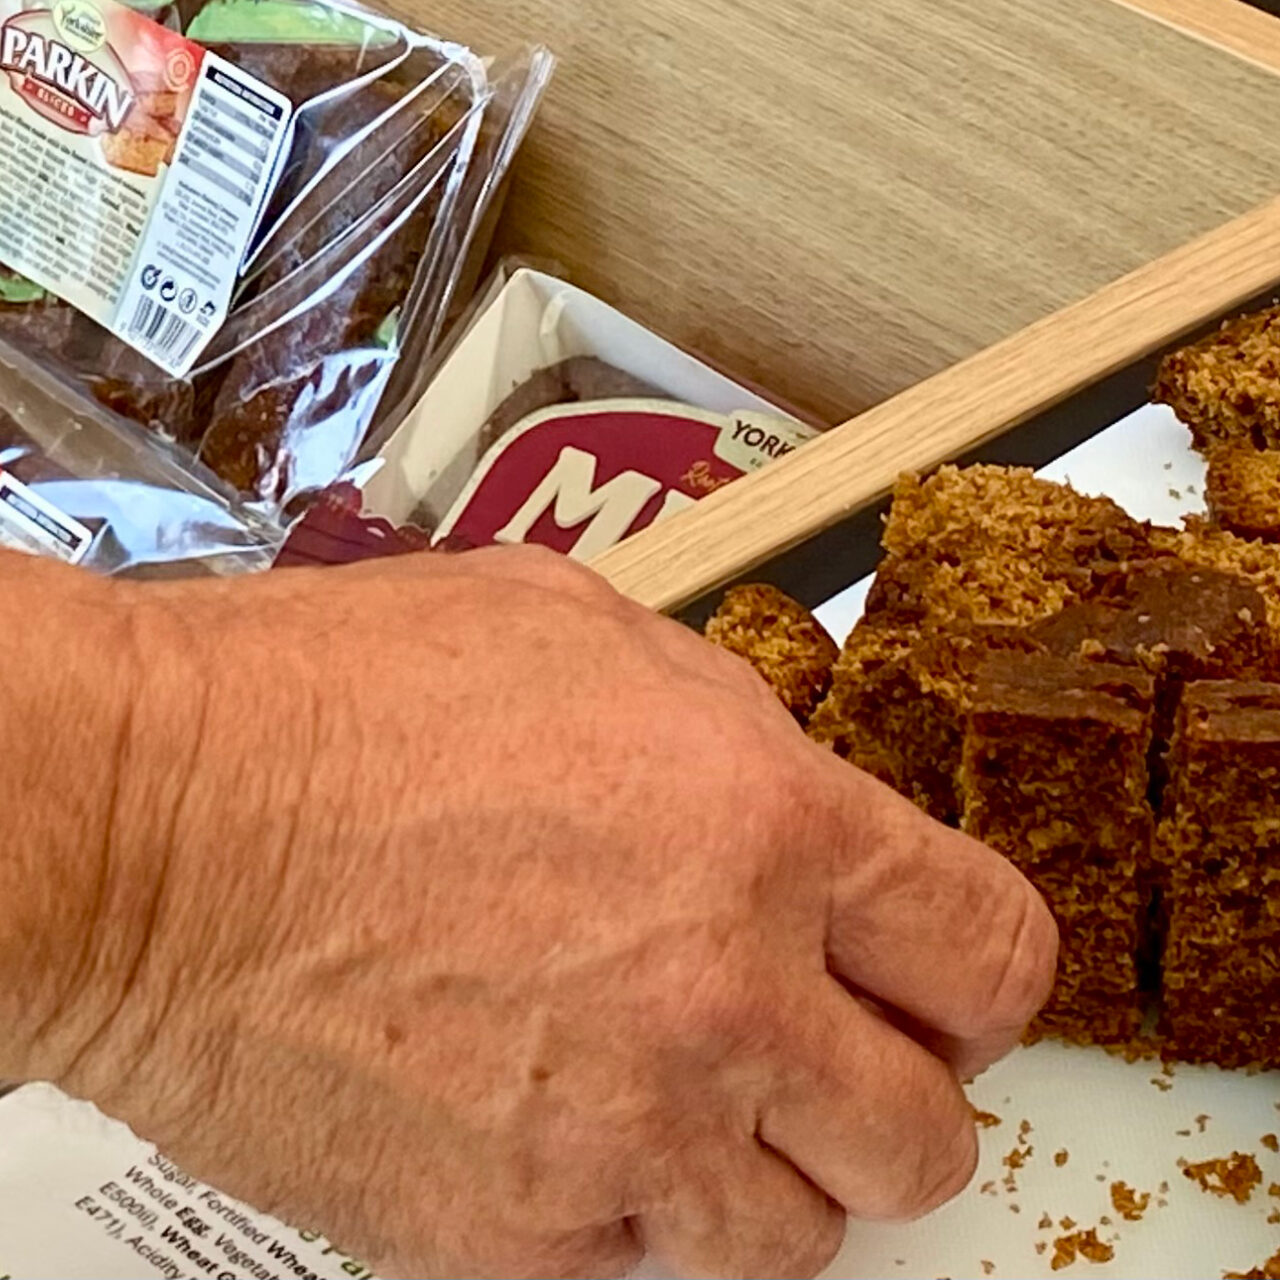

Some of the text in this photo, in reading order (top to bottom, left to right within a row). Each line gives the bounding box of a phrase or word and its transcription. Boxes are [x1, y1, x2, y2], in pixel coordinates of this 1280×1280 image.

[0, 25, 136, 134] PARKIN
[731, 419, 796, 460] YORK
[493, 445, 700, 562] M
[74, 1195, 185, 1280] E471), Acidity
[124, 1164, 179, 1211] Whole
[174, 1206, 213, 1240] Egg,
[147, 1152, 198, 1196] Sugar,
[197, 1189, 271, 1245] Fortified
[160, 1224, 220, 1275] Wheat
